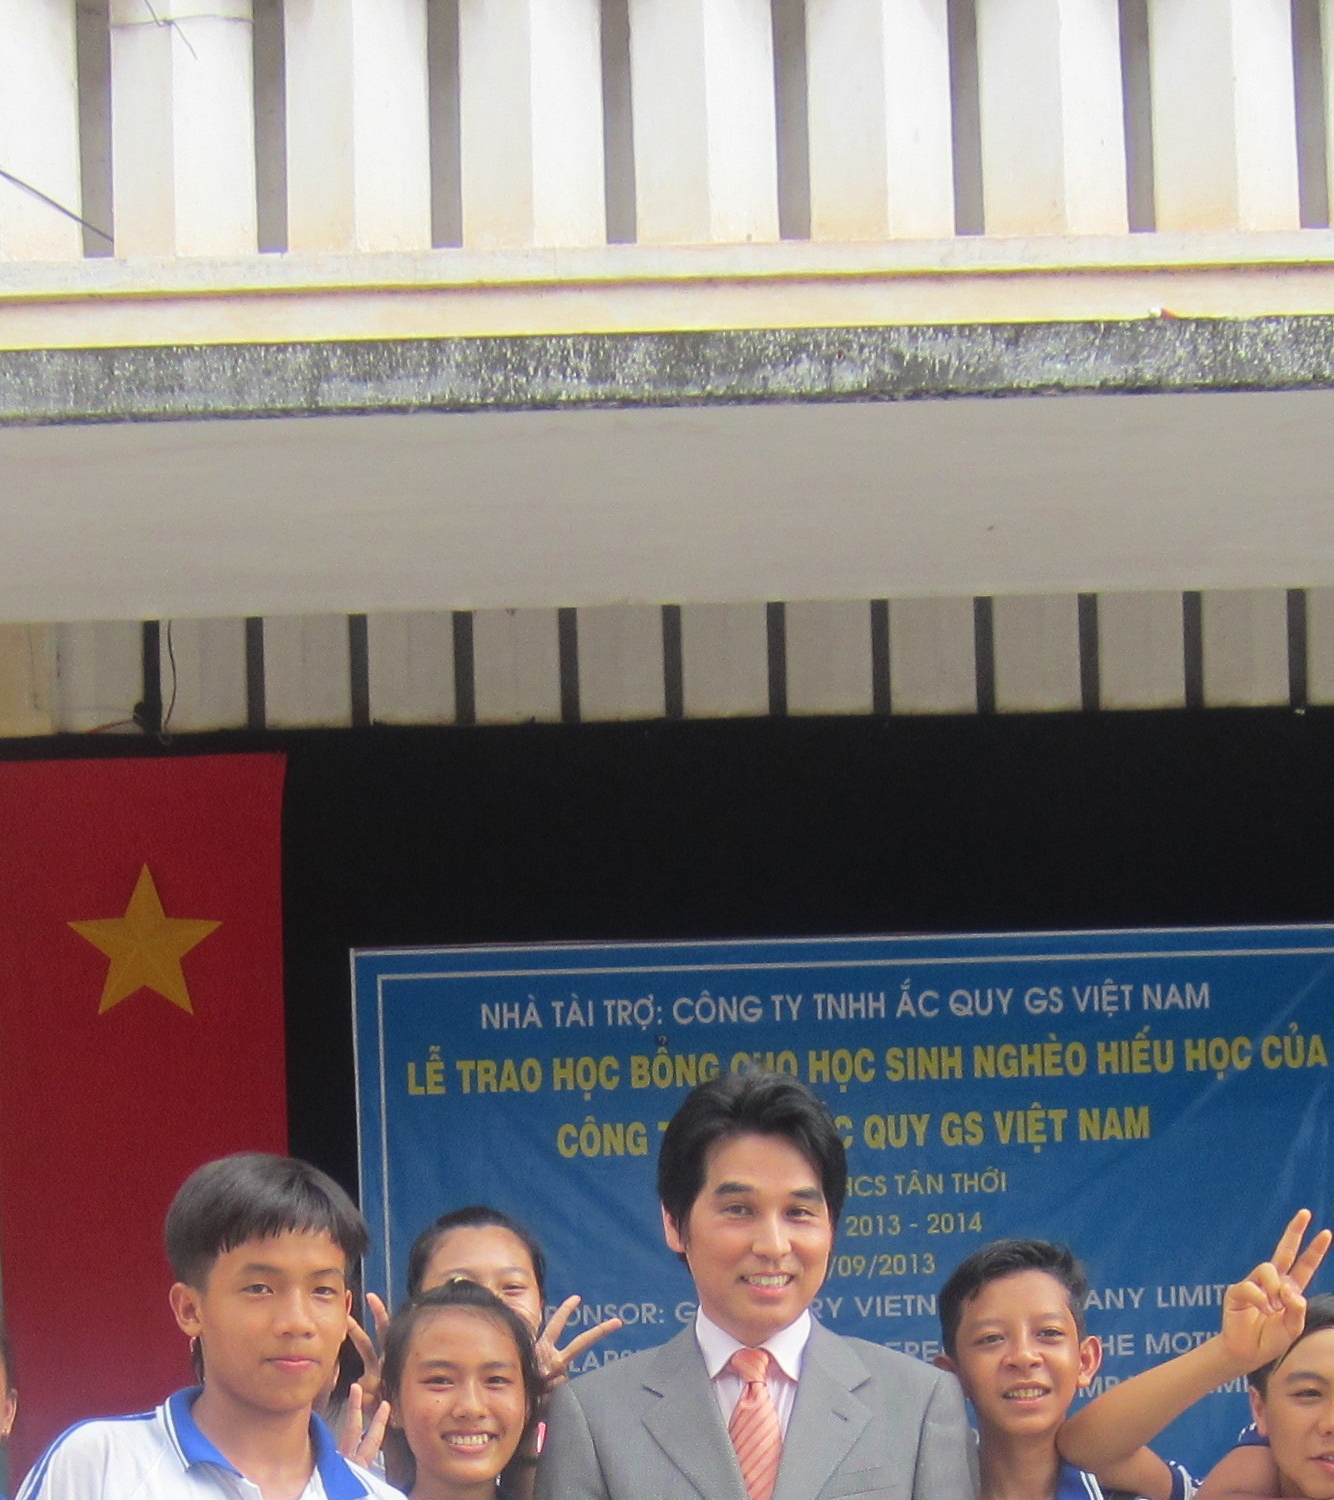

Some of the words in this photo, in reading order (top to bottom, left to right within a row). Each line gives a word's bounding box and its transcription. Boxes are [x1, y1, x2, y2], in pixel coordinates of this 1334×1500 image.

[480, 993, 543, 1030] NHÀ
[551, 993, 595, 1027] TÀI
[603, 994, 663, 1031] TRỢ:
[672, 990, 763, 1026] CÔNG
[771, 994, 804, 1021] TY
[813, 991, 886, 1020] TNHH
[896, 977, 940, 1018] ẮC
[949, 987, 1014, 1017] QUY
[1024, 986, 1064, 1015] GS
[1072, 978, 1134, 1018] VIỆT
[1142, 982, 1211, 1011] NAM
[407, 1045, 447, 1096] LỄ
[456, 1057, 543, 1095] TRAO
[552, 1055, 621, 1101] HỌC
[808, 1047, 875, 1093] HỌC
[886, 1045, 964, 1082] SINH
[973, 1032, 1088, 1079] NGHÈO
[1097, 1025, 1175, 1075] HIẾU
[1184, 1035, 1253, 1081] HỌC
[1261, 1022, 1329, 1070] CỦA
[556, 1115, 649, 1159] CÔNG
[863, 1113, 931, 1150] QUY
[940, 1111, 984, 1147] GS
[993, 1101, 1069, 1154] VIỆT
[1078, 1105, 1151, 1142] NAM
[894, 1169, 944, 1196] TÂN
[951, 1165, 1008, 1193] THỚI
[845, 1214, 902, 1237] 2013
[927, 1211, 983, 1235] 2014
[827, 1252, 936, 1280] /09/2013
[854, 1293, 937, 1318] VIETN
[1084, 1286, 1146, 1311] ANY
[1156, 1283, 1228, 1308] LIMIT
